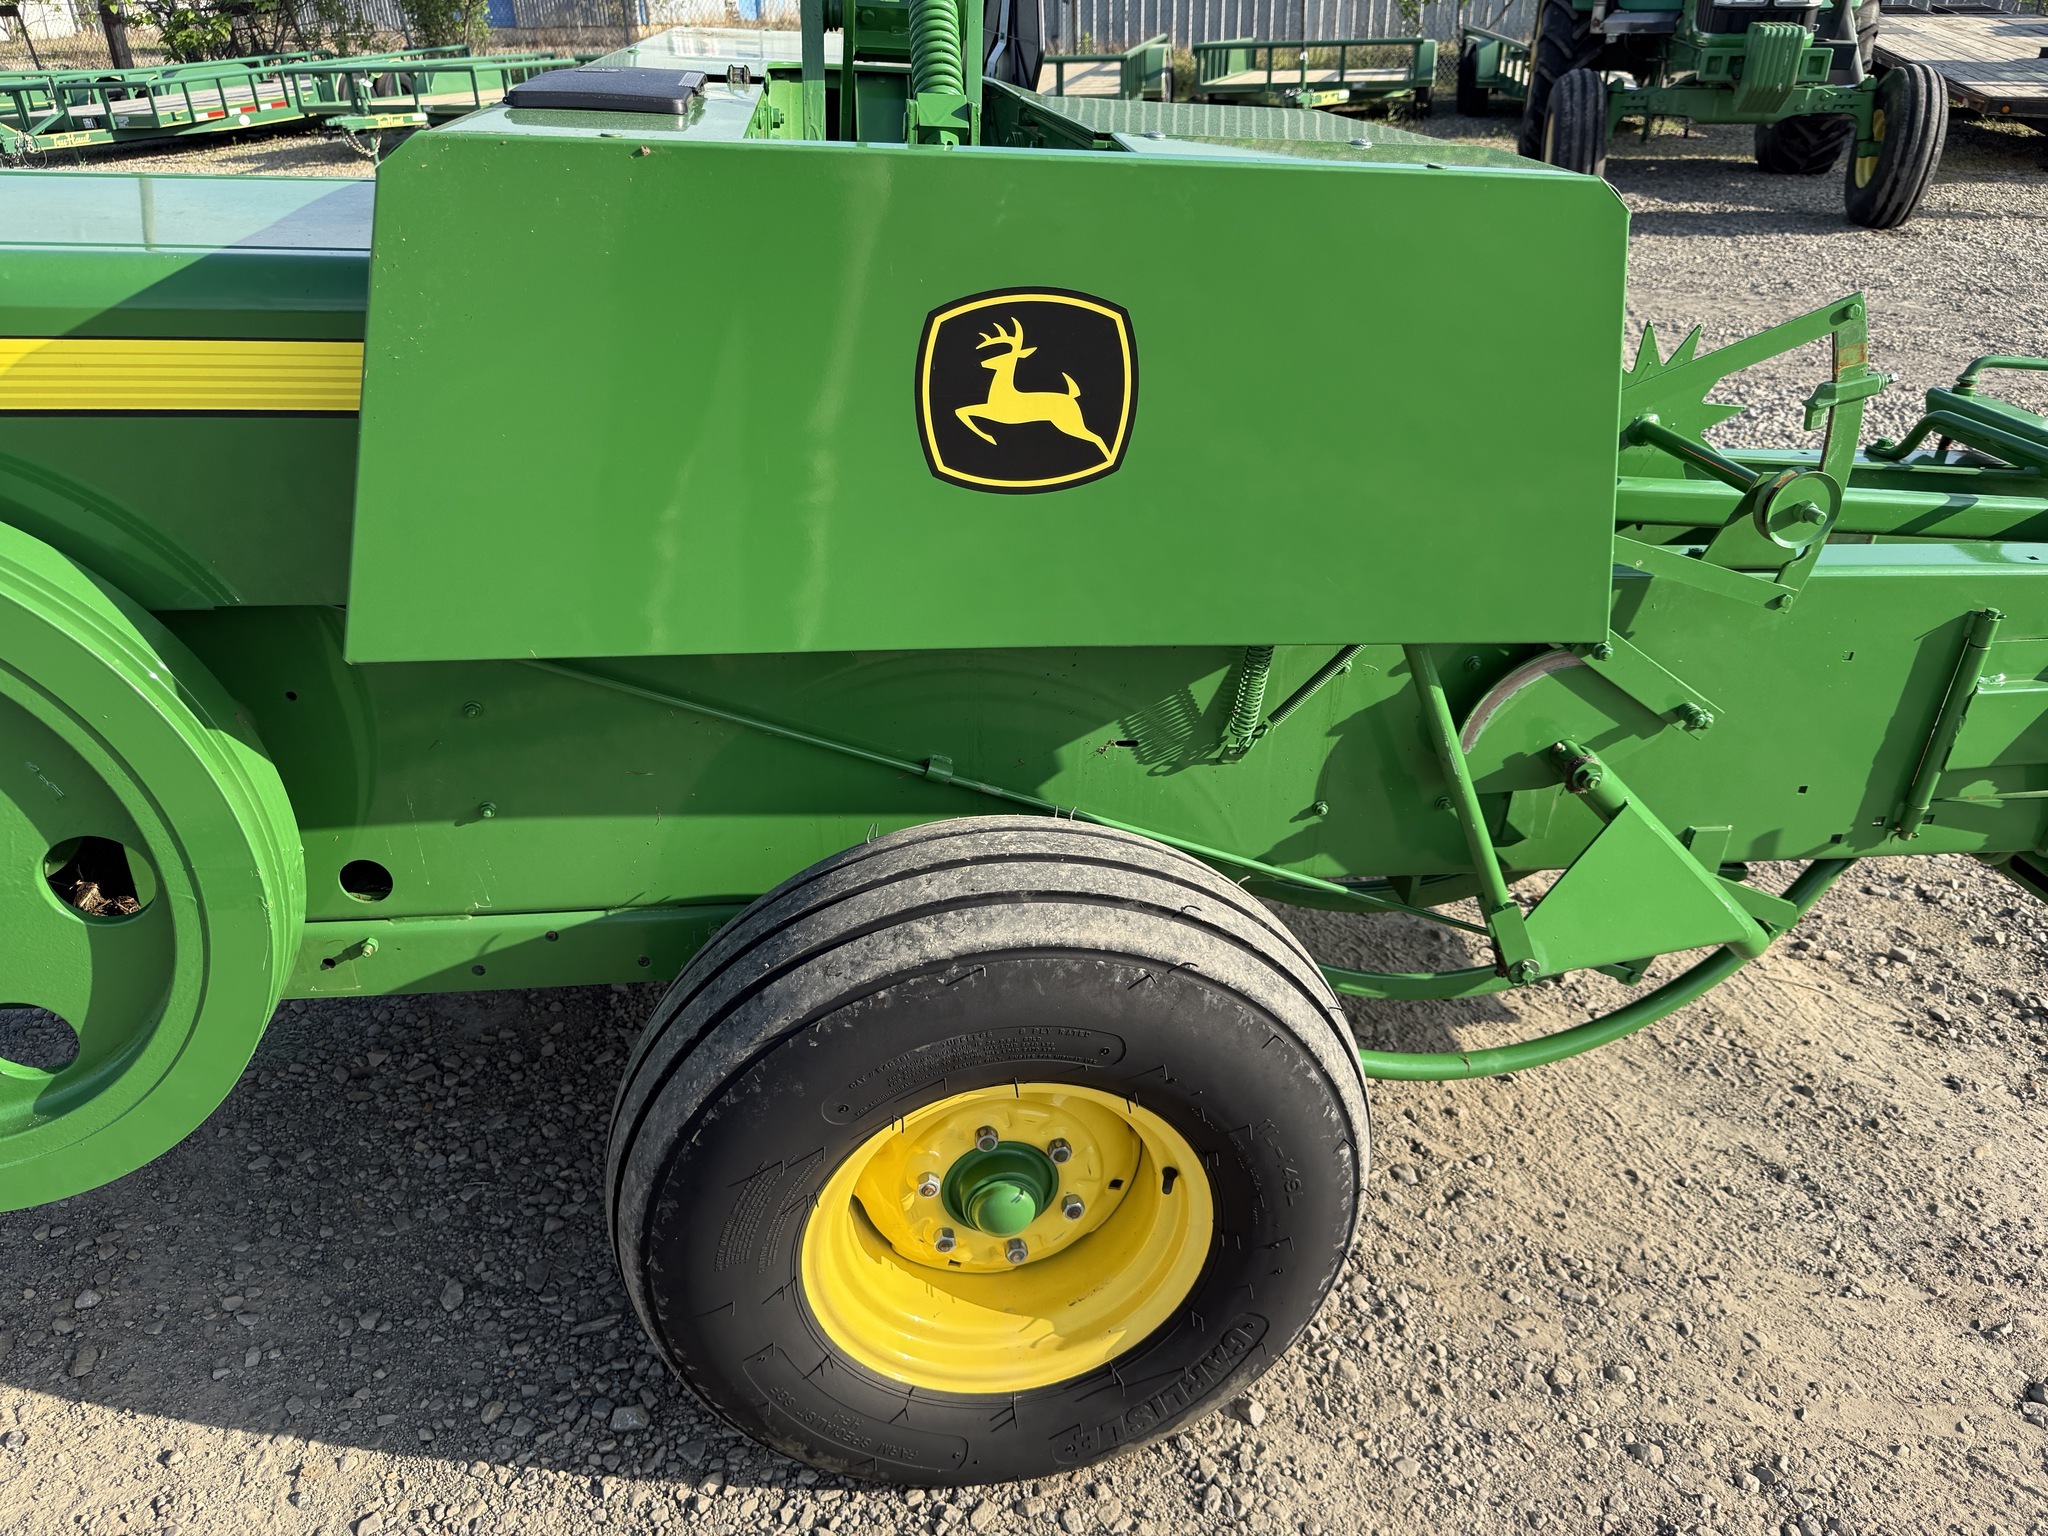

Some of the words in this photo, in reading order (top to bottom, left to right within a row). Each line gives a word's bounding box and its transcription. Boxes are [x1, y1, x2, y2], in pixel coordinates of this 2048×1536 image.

[1073, 1327, 1254, 1457] CARLISLE
[796, 1407, 872, 1448] SPECIALIST
[877, 1442, 919, 1460] FARM
